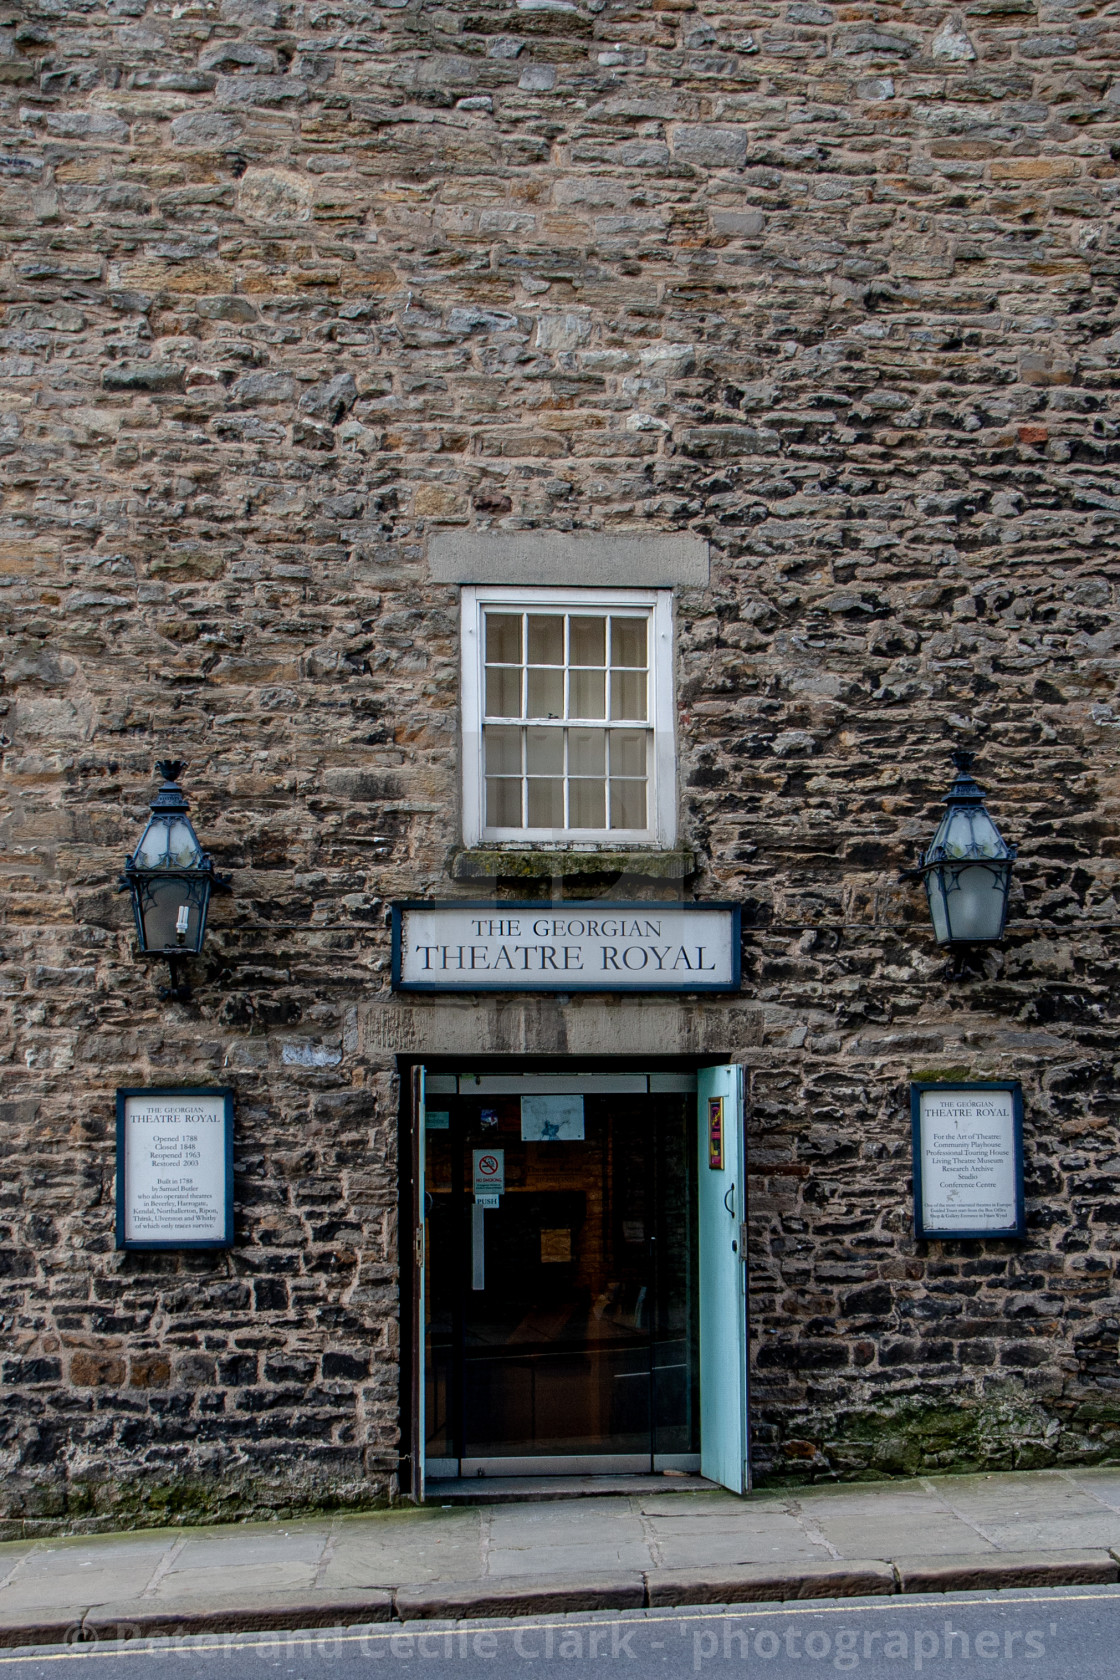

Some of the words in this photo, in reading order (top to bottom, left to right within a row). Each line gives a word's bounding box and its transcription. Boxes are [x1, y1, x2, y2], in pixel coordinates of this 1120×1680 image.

[471, 919, 522, 937] THE
[532, 919, 662, 937] GEORGIAN
[416, 944, 585, 970] THEATRE
[600, 944, 716, 970] ROYAL
[130, 1114, 180, 1123] THEATRE
[185, 1114, 220, 1123] ROYAL
